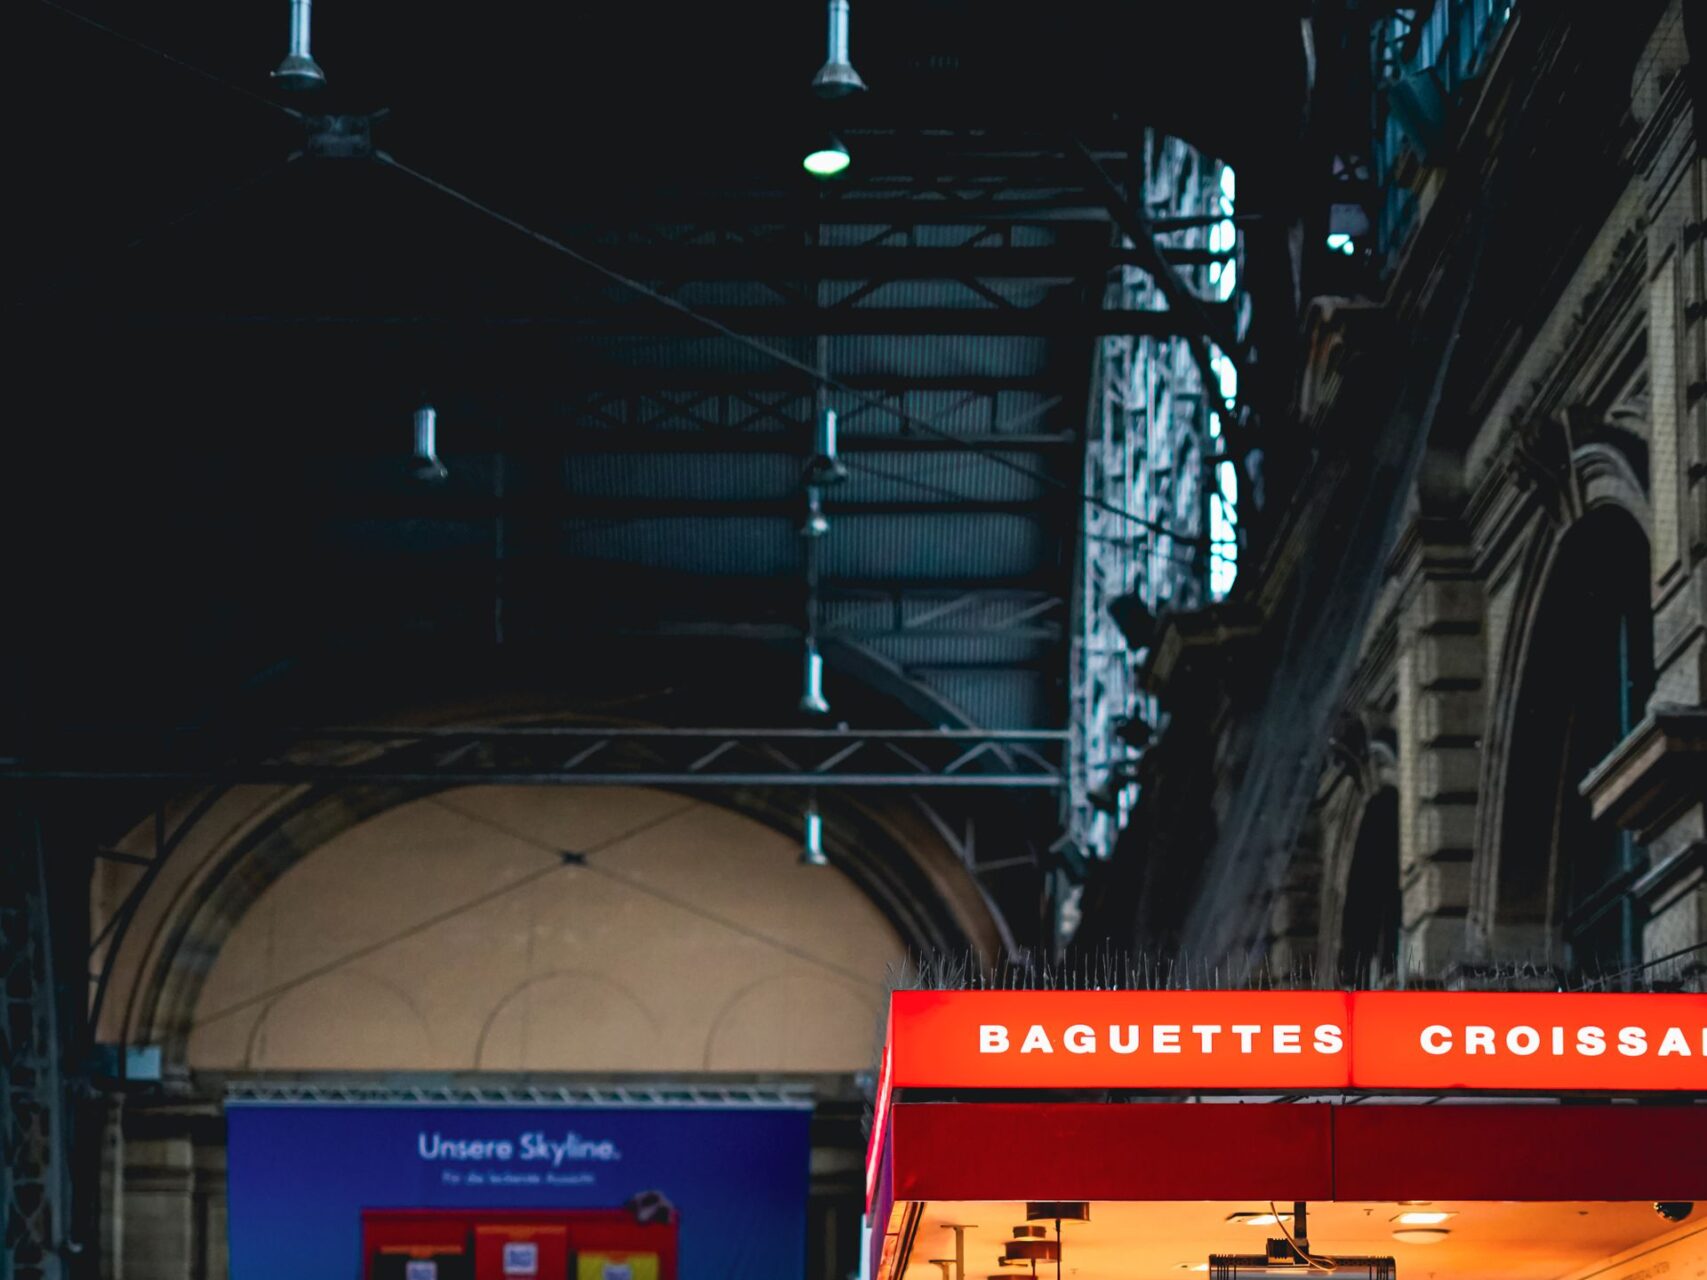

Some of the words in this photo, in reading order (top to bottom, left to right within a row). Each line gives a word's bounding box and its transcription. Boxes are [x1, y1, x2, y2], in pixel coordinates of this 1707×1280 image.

[979, 1024, 1344, 1054] BAGUETTES
[1420, 1025, 1707, 1056] CROISSA
[419, 1131, 513, 1160] Unsere
[519, 1131, 621, 1167] Skyline.
